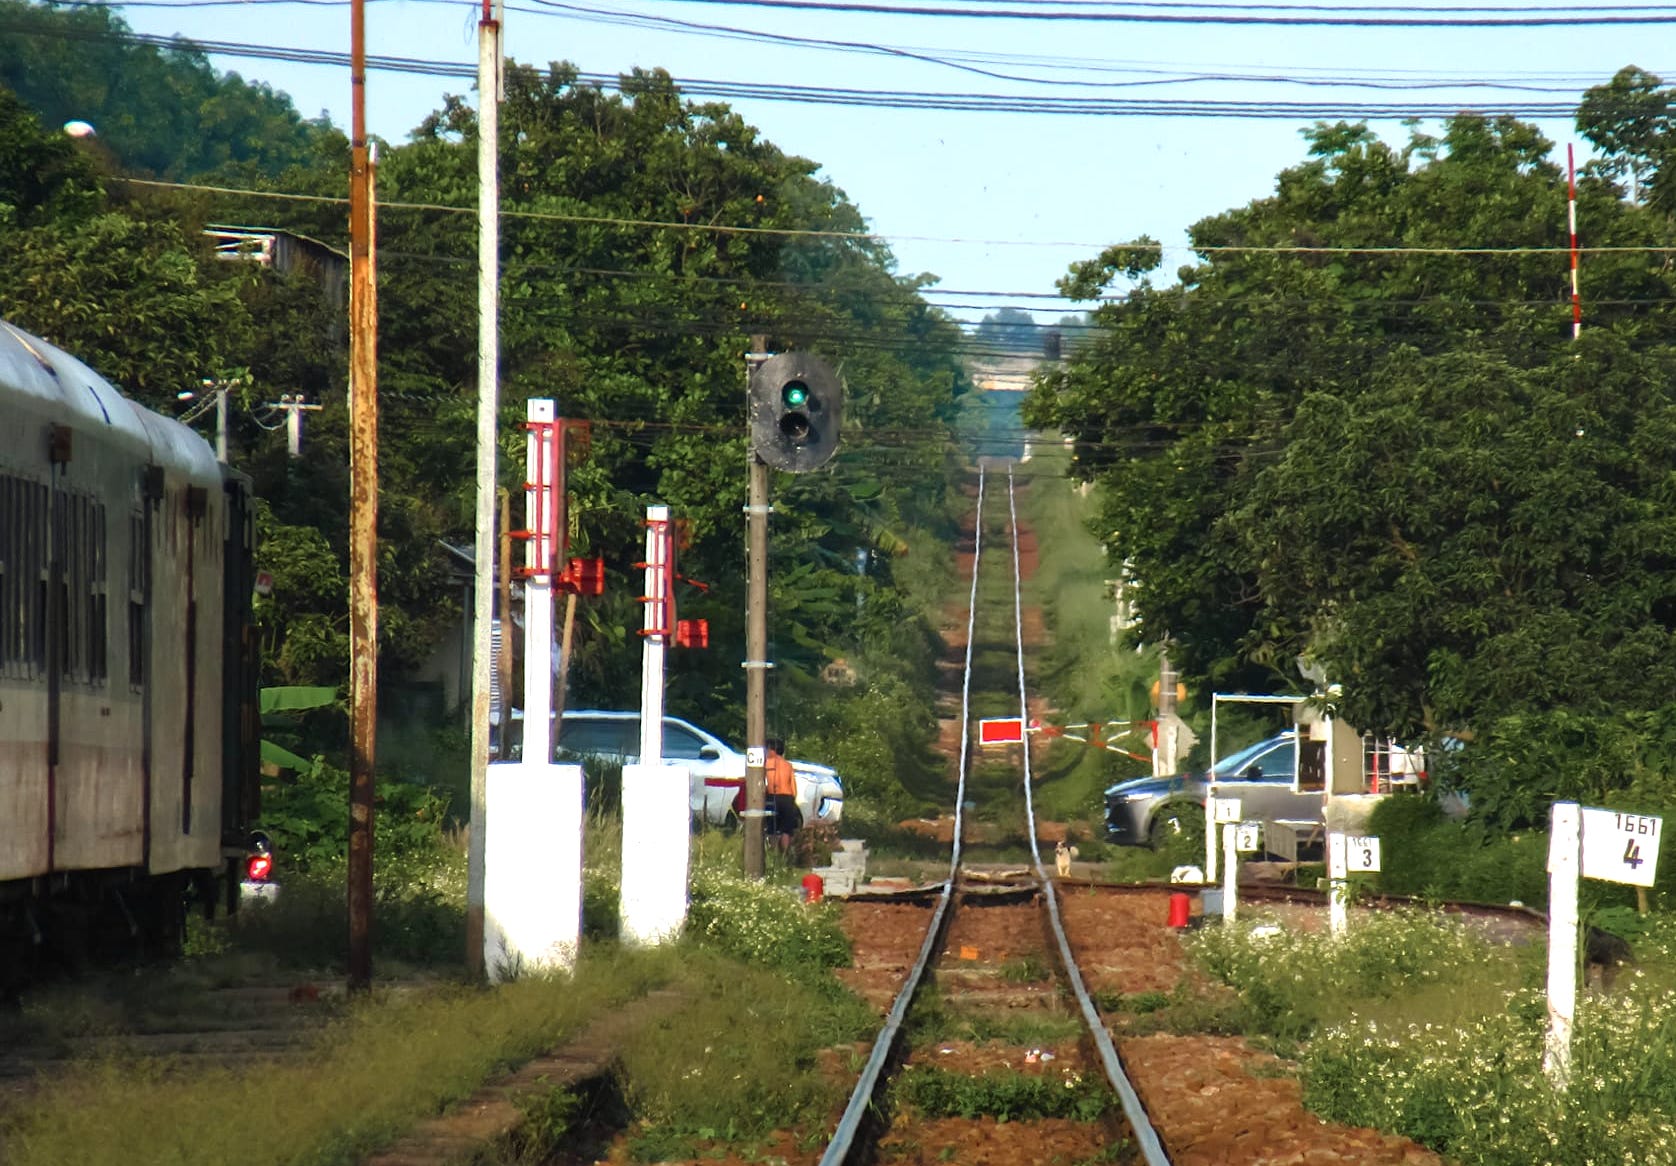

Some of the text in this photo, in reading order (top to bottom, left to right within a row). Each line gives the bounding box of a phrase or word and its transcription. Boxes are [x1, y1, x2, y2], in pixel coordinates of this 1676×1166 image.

[1615, 813, 1656, 836] 1661
[1244, 835, 1251, 848] 2
[1362, 849, 1372, 867] 3
[1623, 838, 1644, 869] 4
